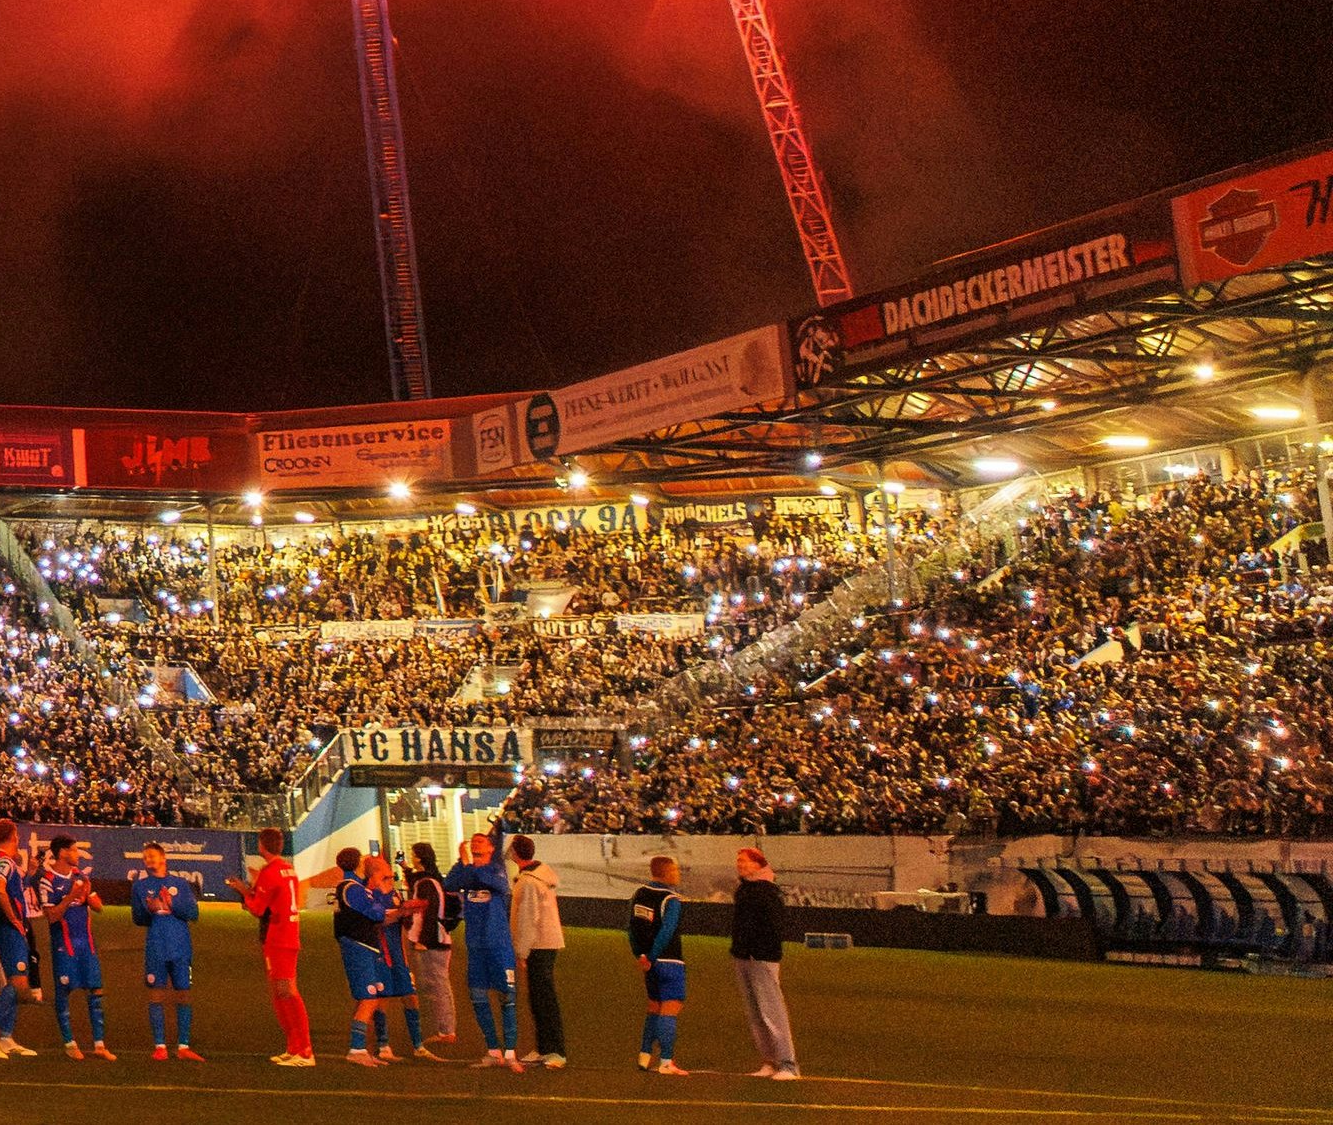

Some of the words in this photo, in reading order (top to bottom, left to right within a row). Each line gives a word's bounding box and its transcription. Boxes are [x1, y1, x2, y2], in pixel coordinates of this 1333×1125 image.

[884, 233, 1129, 335] DACHDECKERMEISTER
[263, 424, 444, 452] Fliesenservice
[352, 729, 389, 762] FC
[400, 728, 525, 763] HANSA
